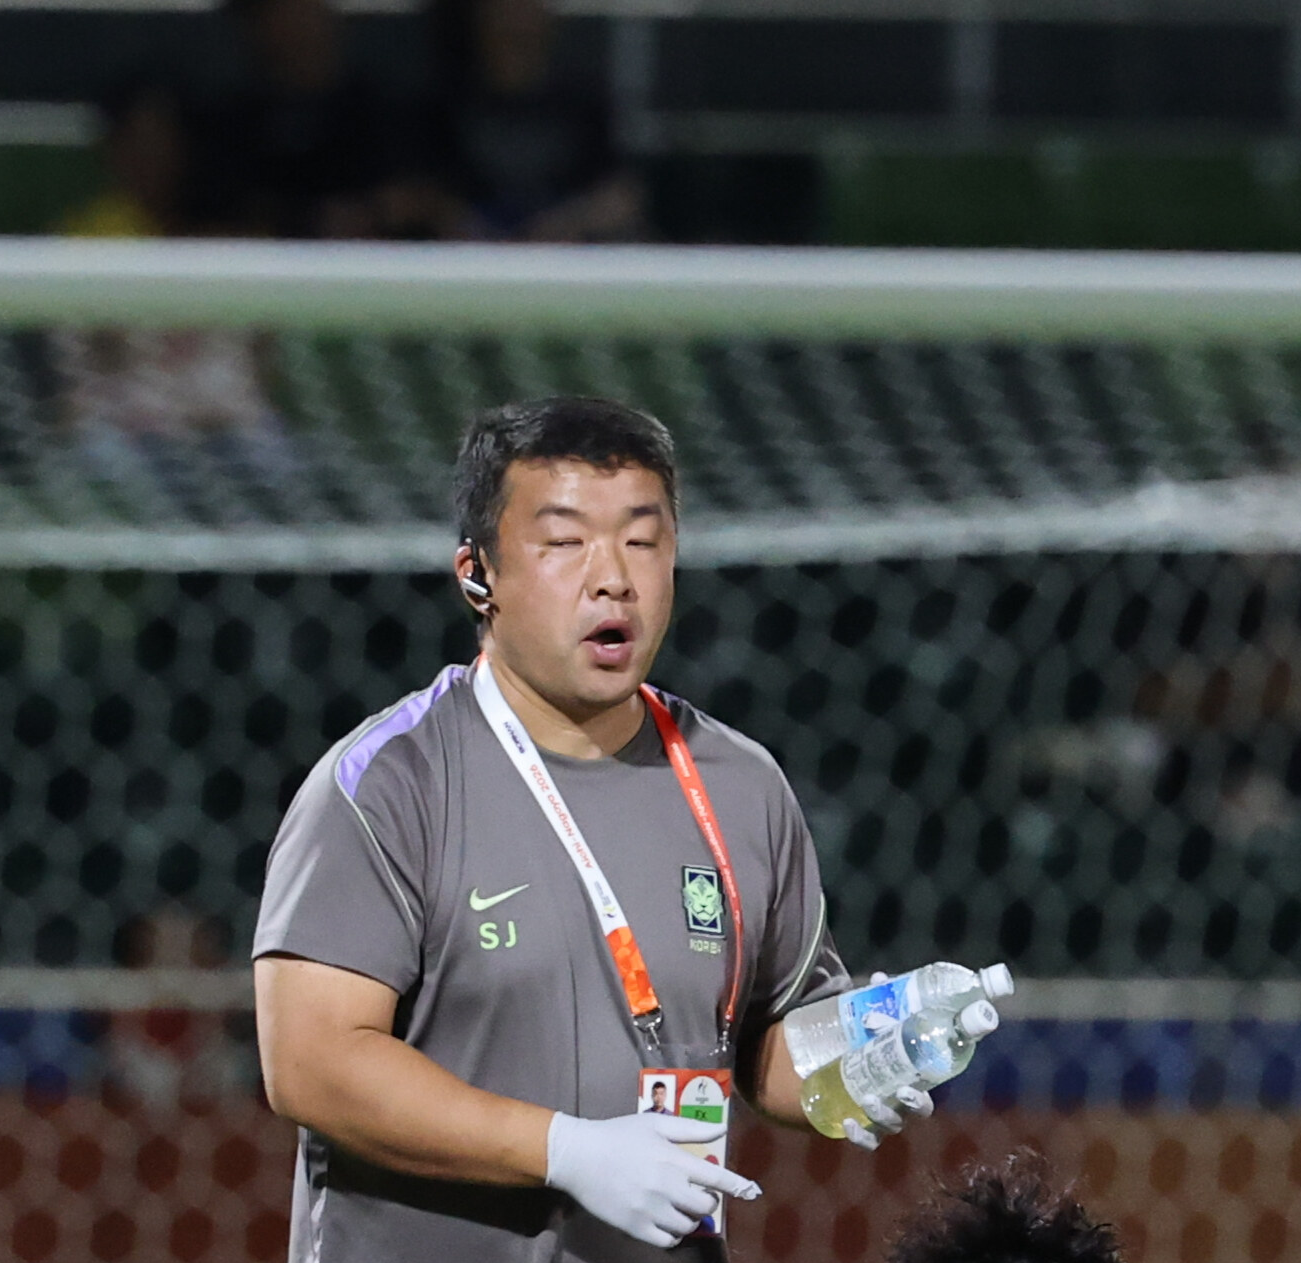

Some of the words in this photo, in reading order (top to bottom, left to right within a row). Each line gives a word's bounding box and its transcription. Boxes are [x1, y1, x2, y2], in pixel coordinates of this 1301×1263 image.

[529, 763, 550, 792] 2026
[547, 794, 594, 869] Aichi-Nagoya
[479, 920, 517, 950] SJ
